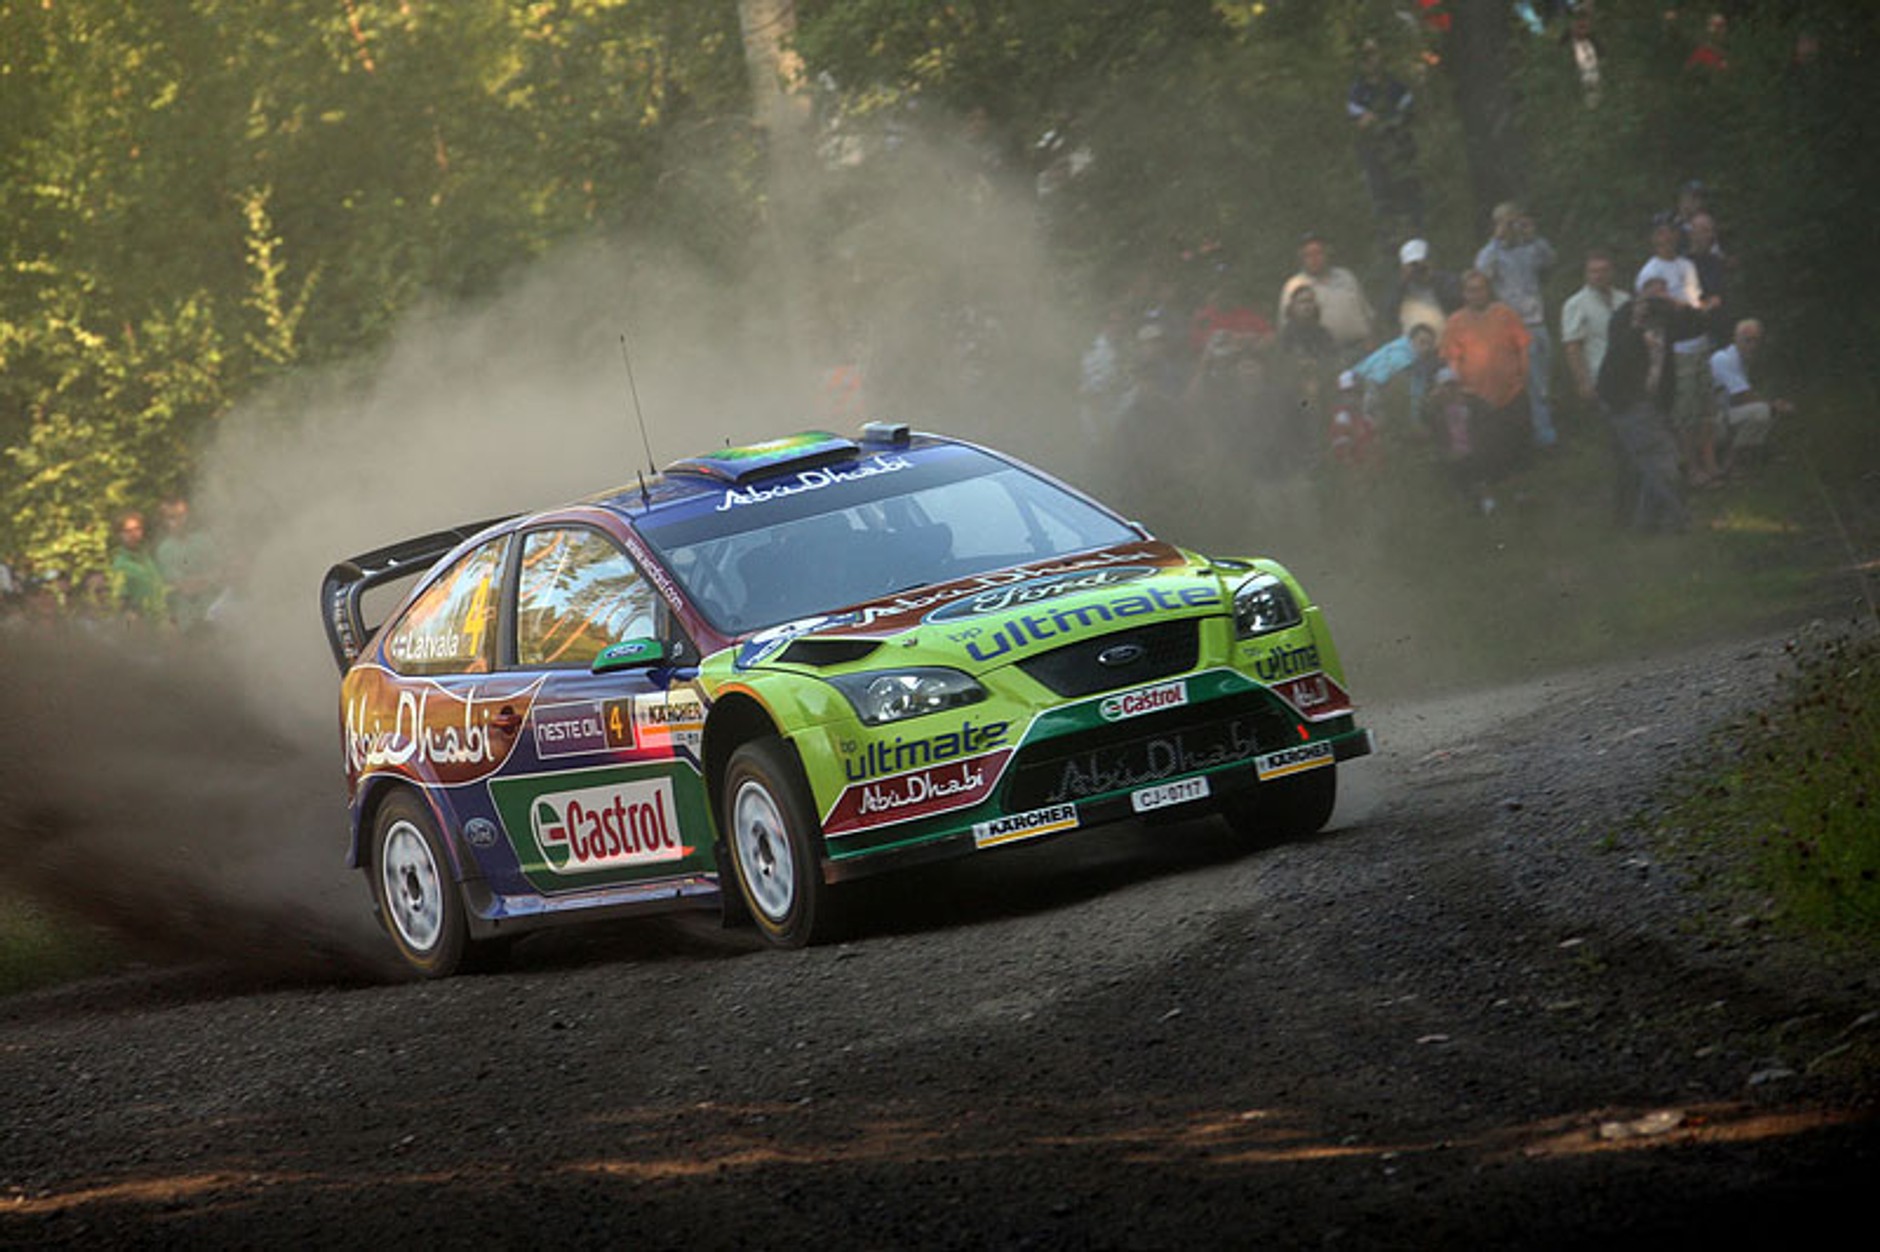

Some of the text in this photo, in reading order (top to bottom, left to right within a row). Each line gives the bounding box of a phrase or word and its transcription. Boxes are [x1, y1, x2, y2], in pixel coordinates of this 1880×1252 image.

[464, 577, 490, 656] 4
[973, 572, 1126, 613] Ford
[406, 627, 459, 659] Latvala
[965, 586, 1221, 662] ultimate
[610, 705, 623, 740] 4
[1123, 685, 1184, 714] Castrol
[846, 721, 1010, 781] ultimate
[566, 788, 675, 863] Castrol
